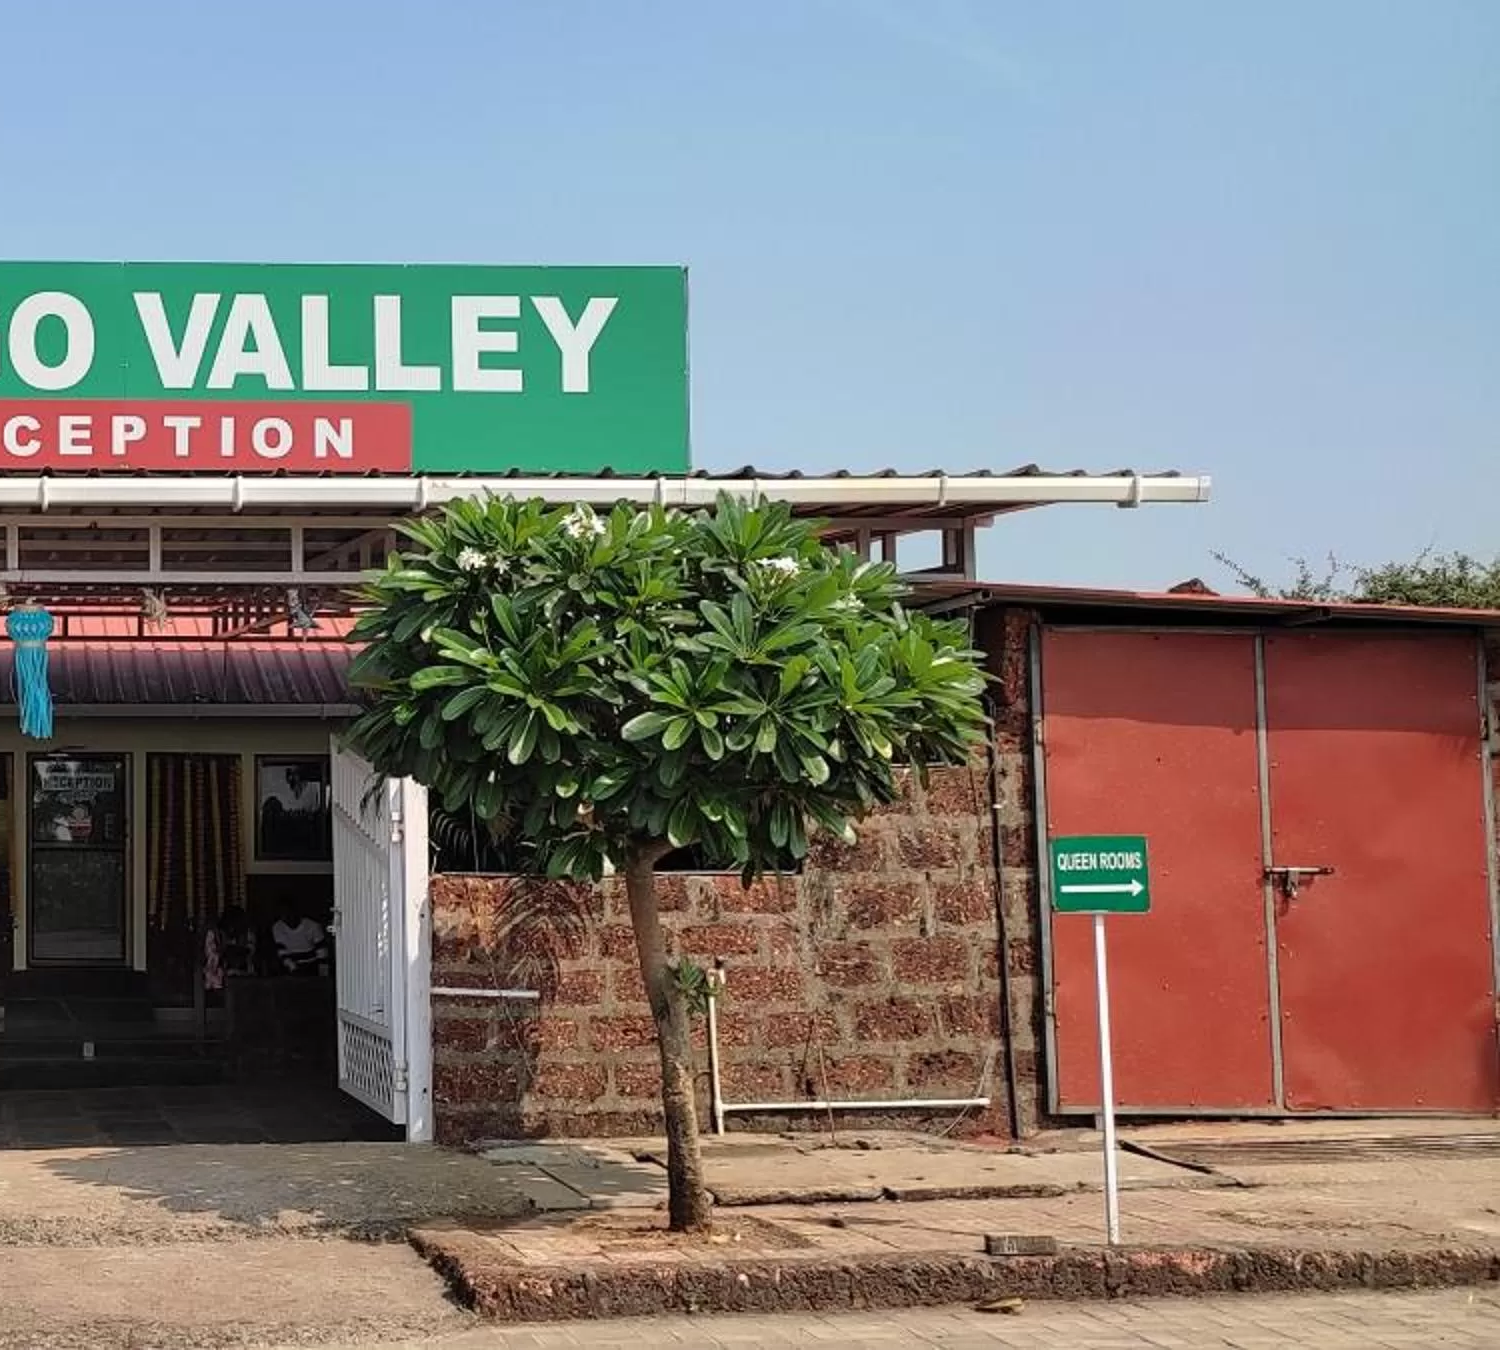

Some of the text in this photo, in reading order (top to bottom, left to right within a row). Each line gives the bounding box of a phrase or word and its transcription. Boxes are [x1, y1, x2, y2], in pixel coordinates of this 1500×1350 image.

[133, 292, 619, 393] VALLEY
[1057, 851, 1143, 871] QUEEN ROOMS
